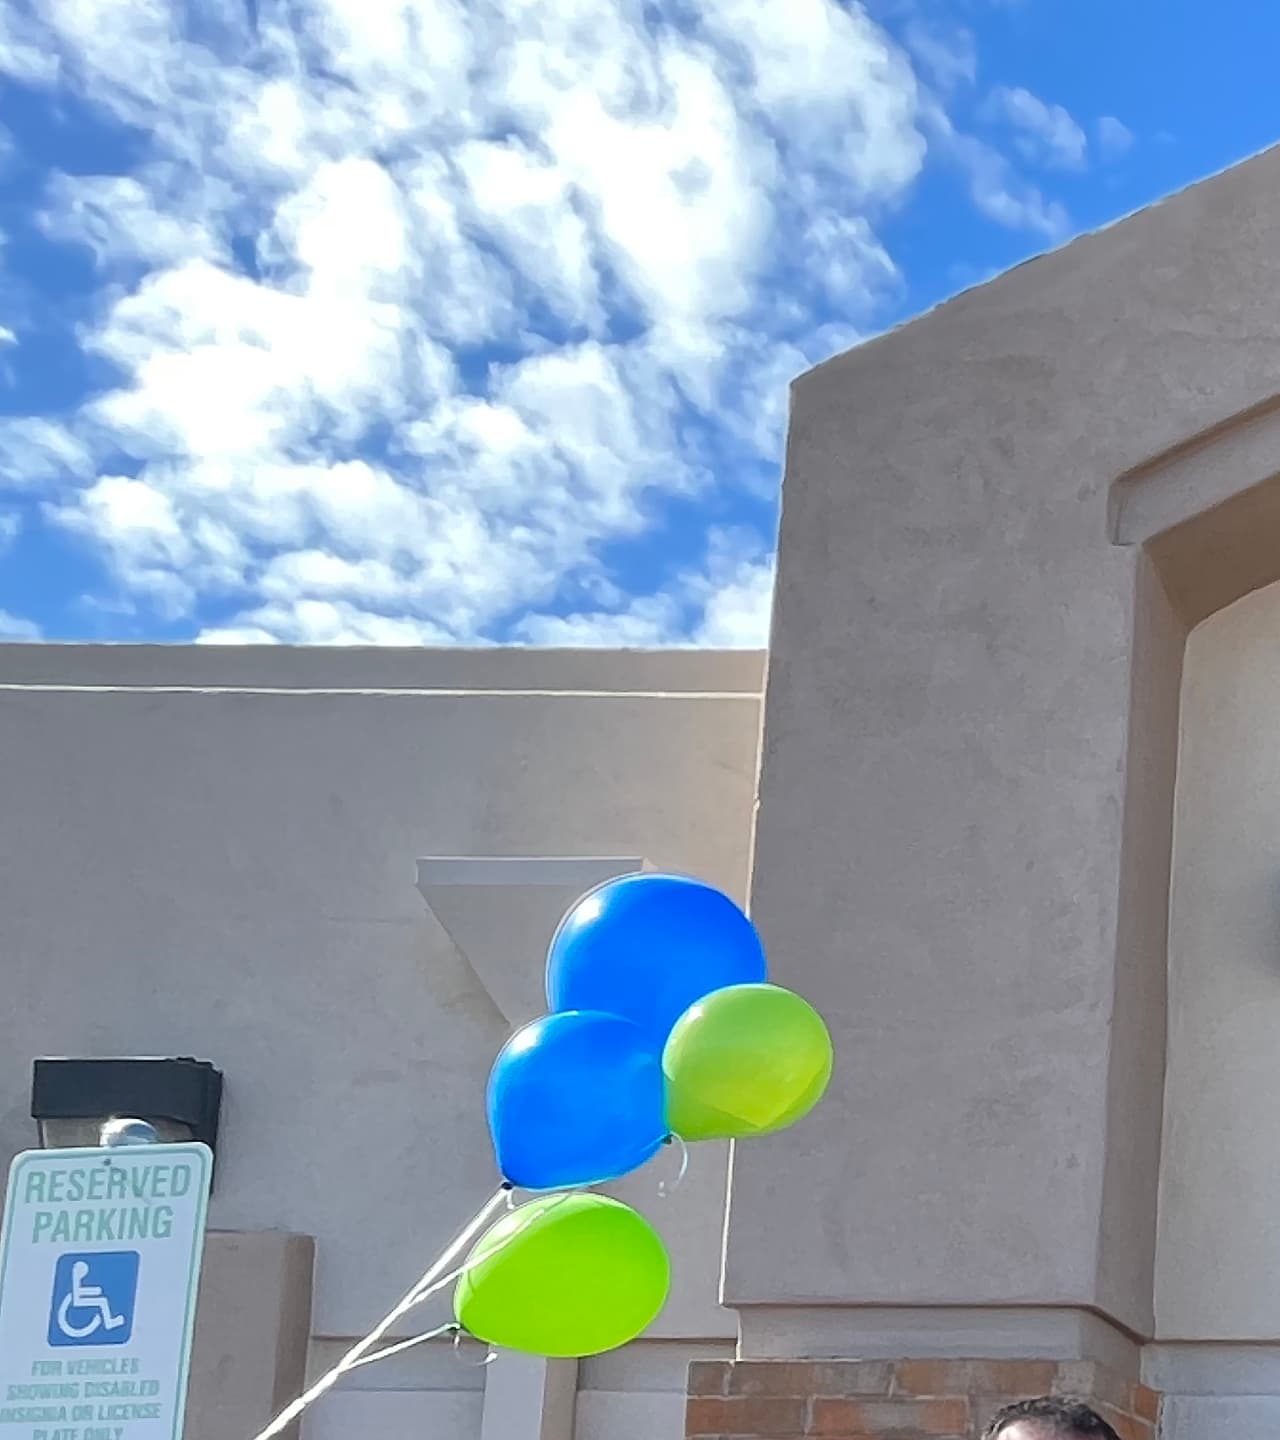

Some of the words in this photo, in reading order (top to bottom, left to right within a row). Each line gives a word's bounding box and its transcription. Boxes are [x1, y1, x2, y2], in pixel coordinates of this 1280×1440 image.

[24, 1163, 192, 1204] RESERVED
[31, 1204, 175, 1244] PARKING
[67, 1357, 141, 1376] VEHICLES
[97, 1402, 162, 1420] LICENSE
